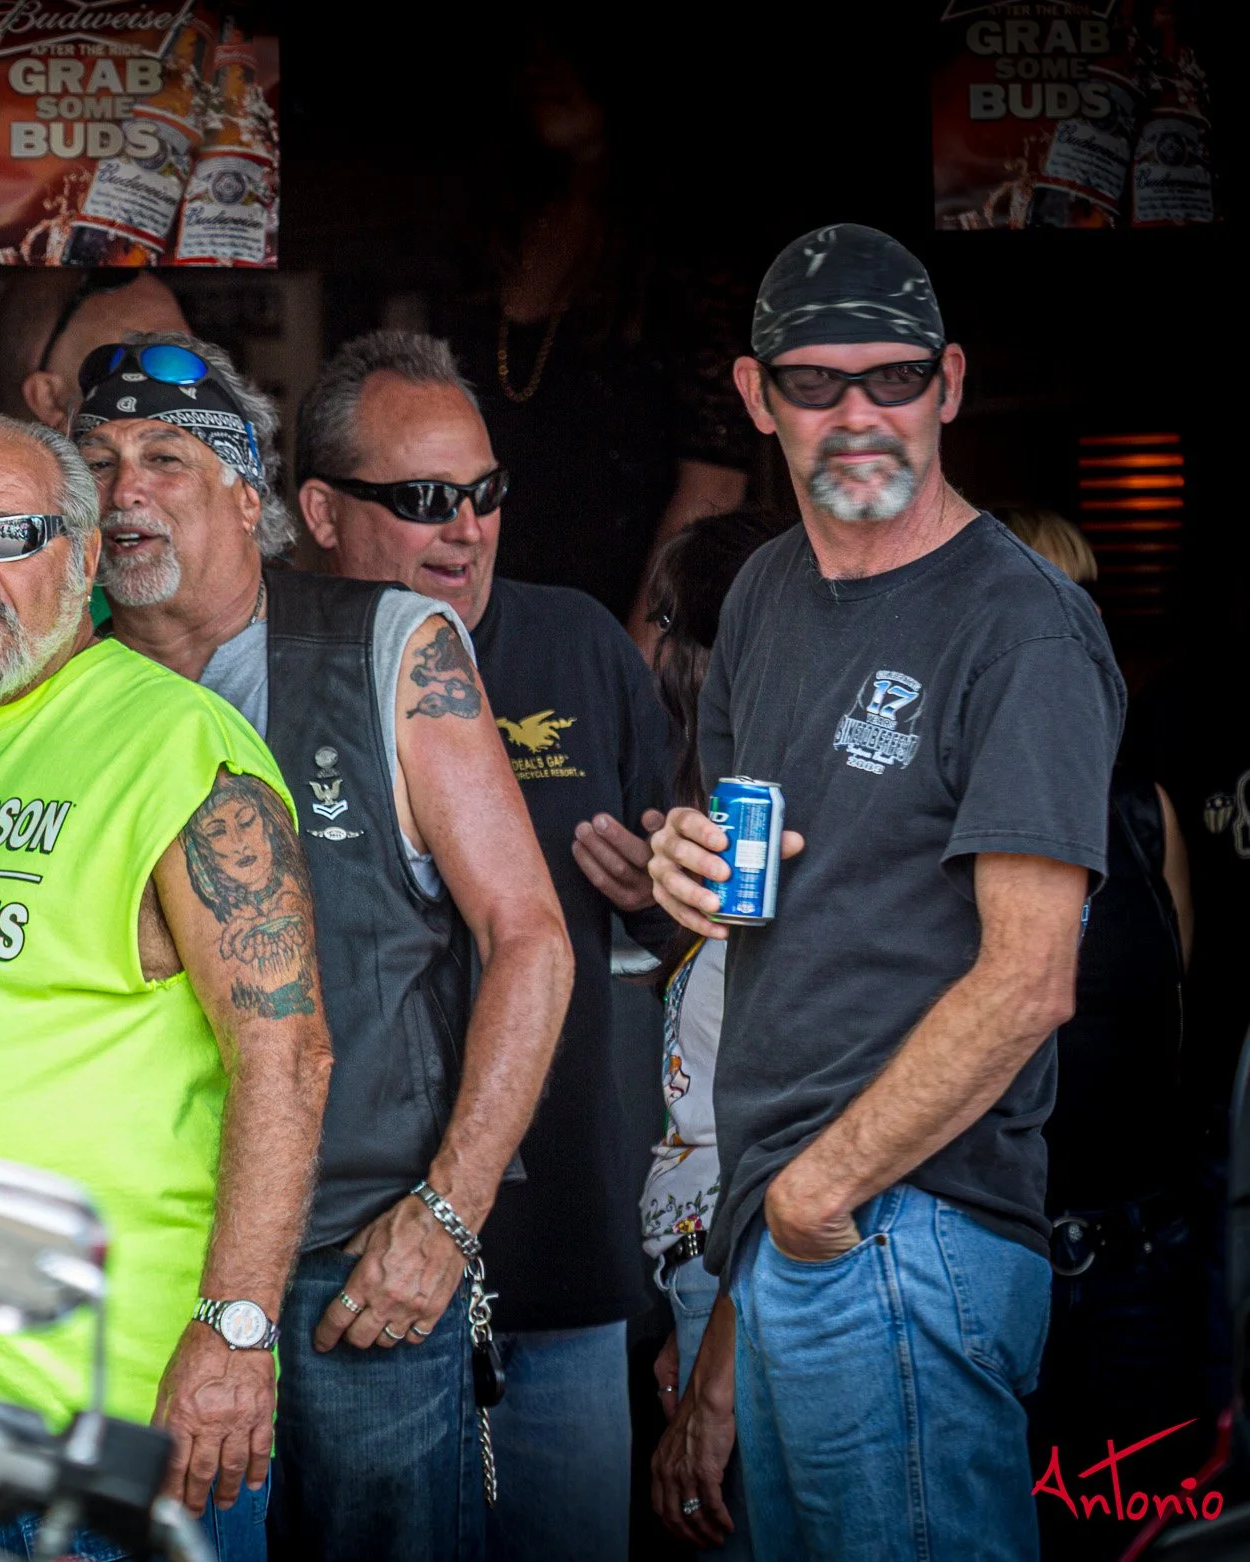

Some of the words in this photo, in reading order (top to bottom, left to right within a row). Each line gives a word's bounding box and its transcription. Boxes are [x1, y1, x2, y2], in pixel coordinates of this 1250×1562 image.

[78, 44, 106, 56] THE
[965, 19, 1111, 55] GRAB
[8, 58, 164, 95] GRAB
[995, 57, 1089, 80] SOME
[36, 96, 135, 120] SOME
[968, 82, 1112, 120] BUDS
[10, 121, 161, 159] BUDS
[867, 680, 919, 720] 17
